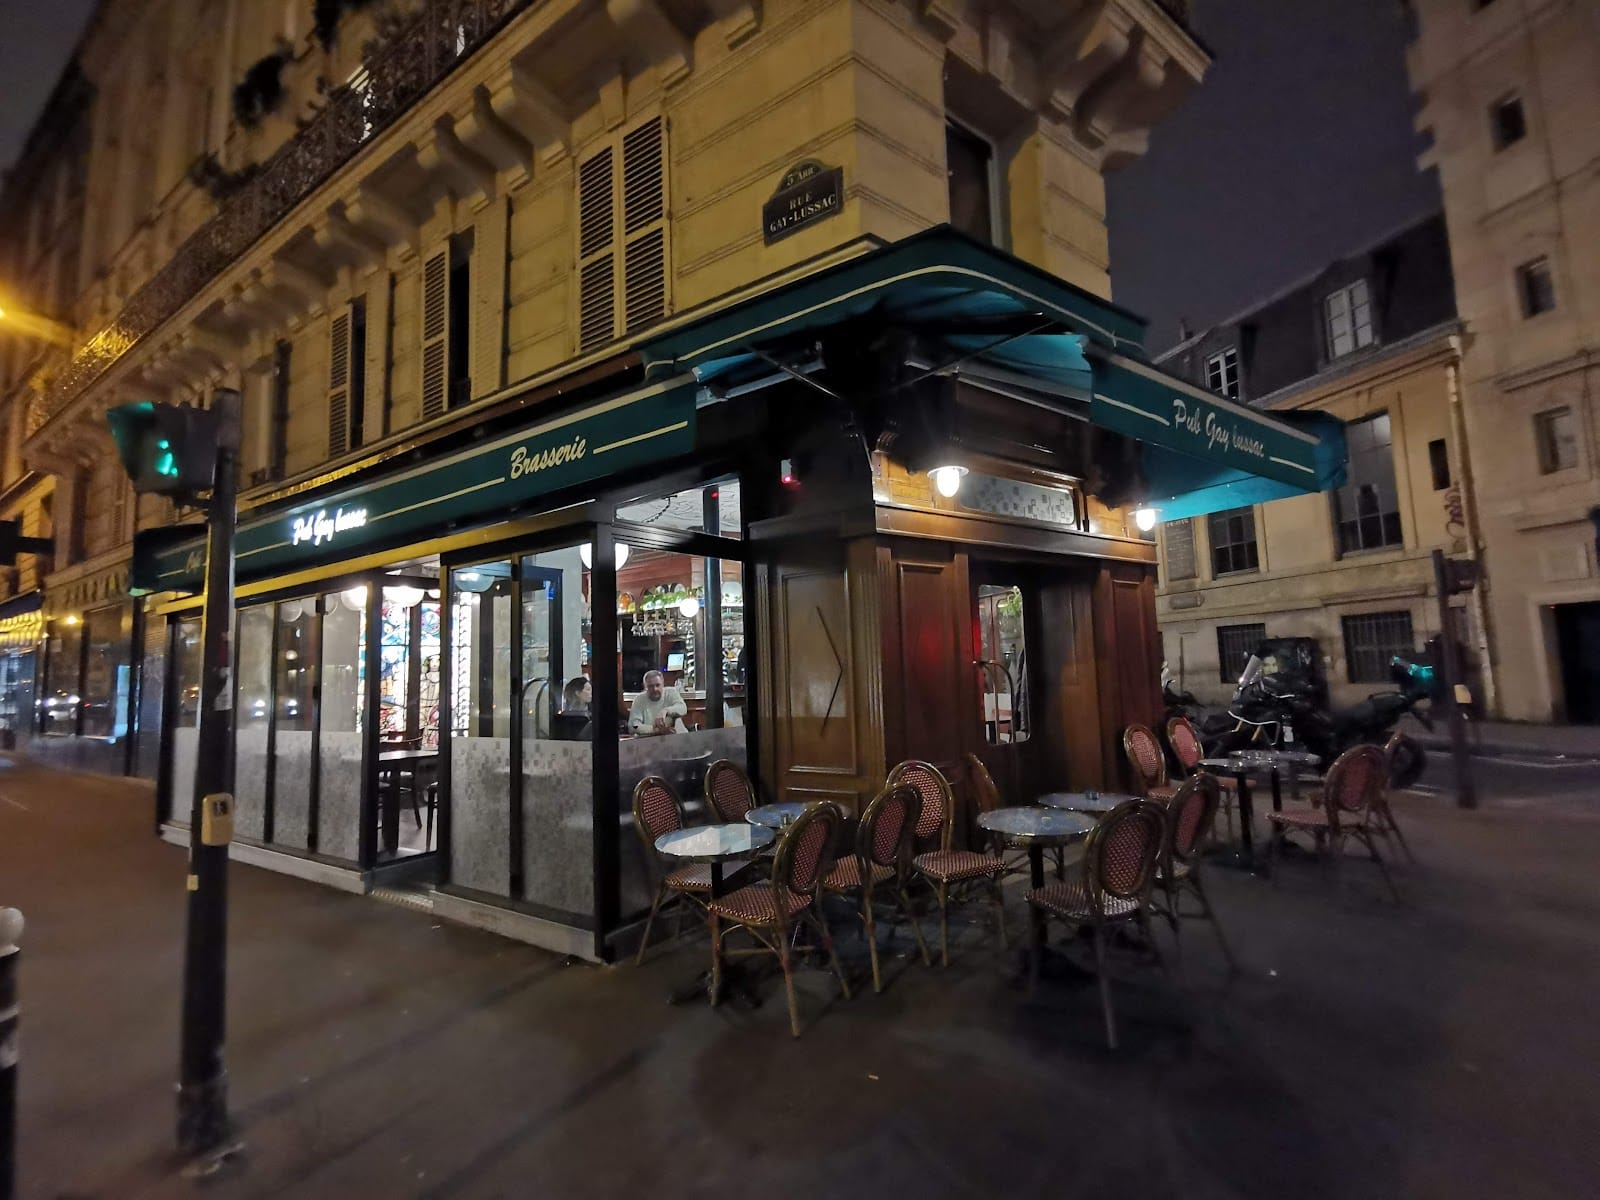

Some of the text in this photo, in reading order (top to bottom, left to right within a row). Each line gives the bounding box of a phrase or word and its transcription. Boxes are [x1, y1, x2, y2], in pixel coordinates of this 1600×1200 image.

[769, 193, 836, 233] GAY-LUSSAC
[789, 192, 812, 210] RUE
[1173, 399, 1201, 435] Pub
[1205, 412, 1230, 453] Gay
[510, 435, 587, 480] Brasserie
